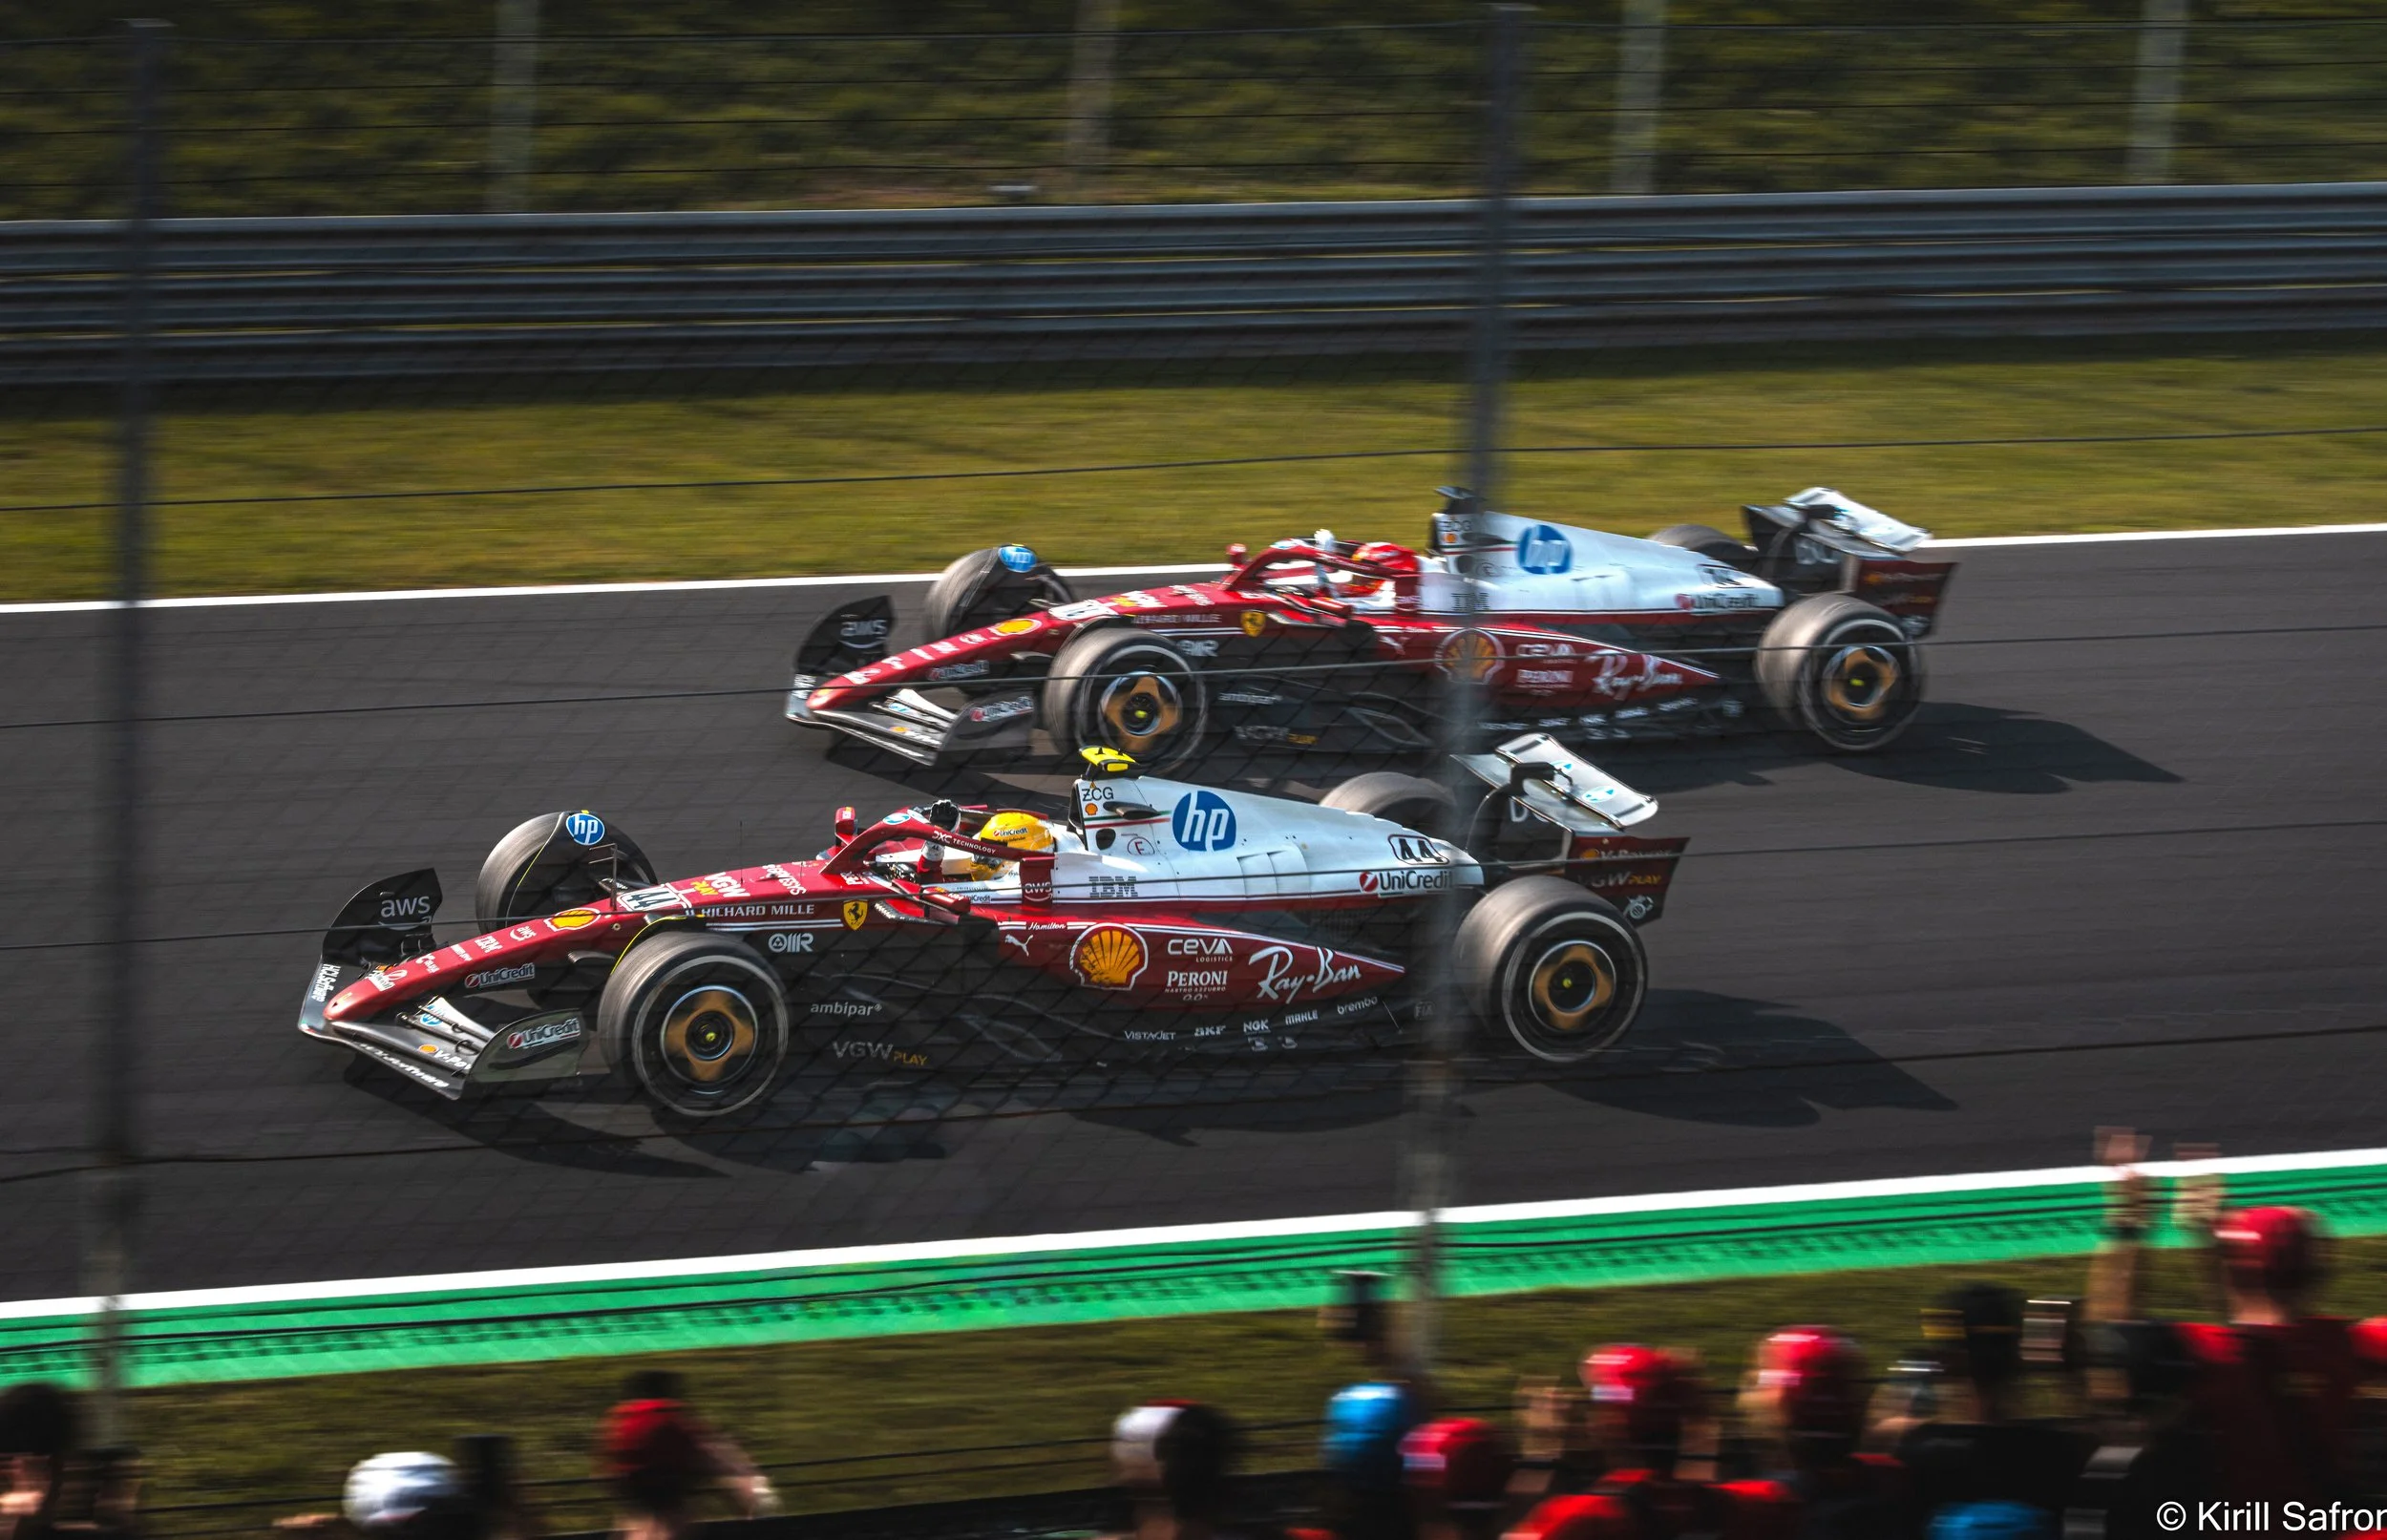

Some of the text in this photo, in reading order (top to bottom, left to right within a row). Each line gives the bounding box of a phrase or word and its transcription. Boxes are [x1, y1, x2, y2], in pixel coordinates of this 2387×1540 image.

[1082, 787, 1114, 801] ZCG
[573, 813, 596, 845] hp
[1181, 791, 1230, 852] hp
[953, 839, 996, 854] TECHNOLOGY
[1025, 882, 1052, 895] aws
[1088, 875, 1139, 897] IBM
[380, 896, 431, 918] aws
[626, 891, 677, 909] 44
[701, 904, 814, 918] RICHARD MILLE
[1028, 921, 1067, 930] Hamilton
[480, 964, 535, 984] UniCredit
[1167, 970, 1228, 987] PERONI
[1337, 996, 1378, 1015] brembo
[1243, 1020, 1269, 1032] NGK
[1285, 1009, 1319, 1025] MAHLE
[523, 1019, 580, 1043] UniCredit
[833, 1041, 894, 1060] VGW
